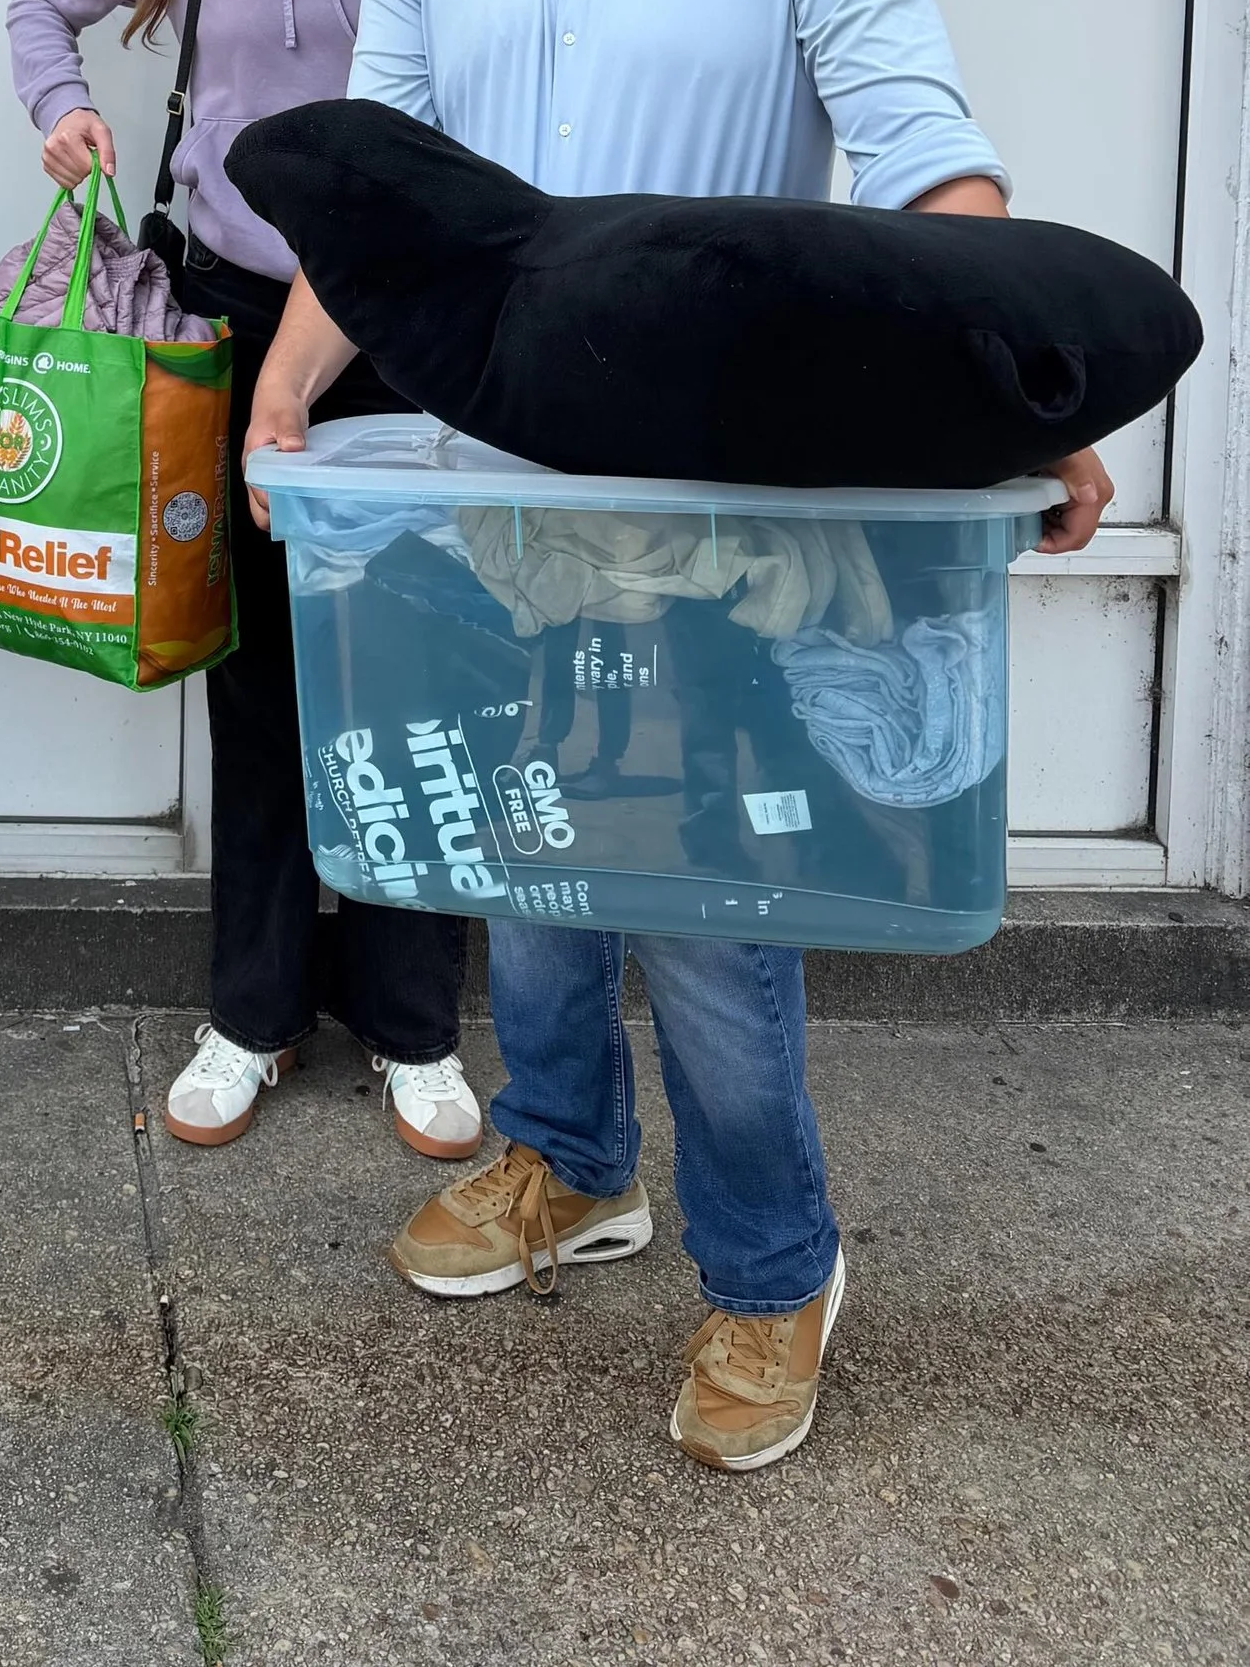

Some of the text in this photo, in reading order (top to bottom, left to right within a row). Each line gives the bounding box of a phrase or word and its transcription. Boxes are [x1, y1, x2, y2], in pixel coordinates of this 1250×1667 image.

[148, 451, 160, 586] Sincerity Sacrifice Service
[6, 582, 26, 597] Who
[71, 597, 89, 610] The
[91, 599, 118, 613] Most
[3, 610, 23, 623] New
[75, 631, 93, 642] NY
[95, 632, 128, 644] 11040
[588, 637, 602, 652] in
[505, 788, 532, 834] FREE
[524, 760, 575, 849] GMO
